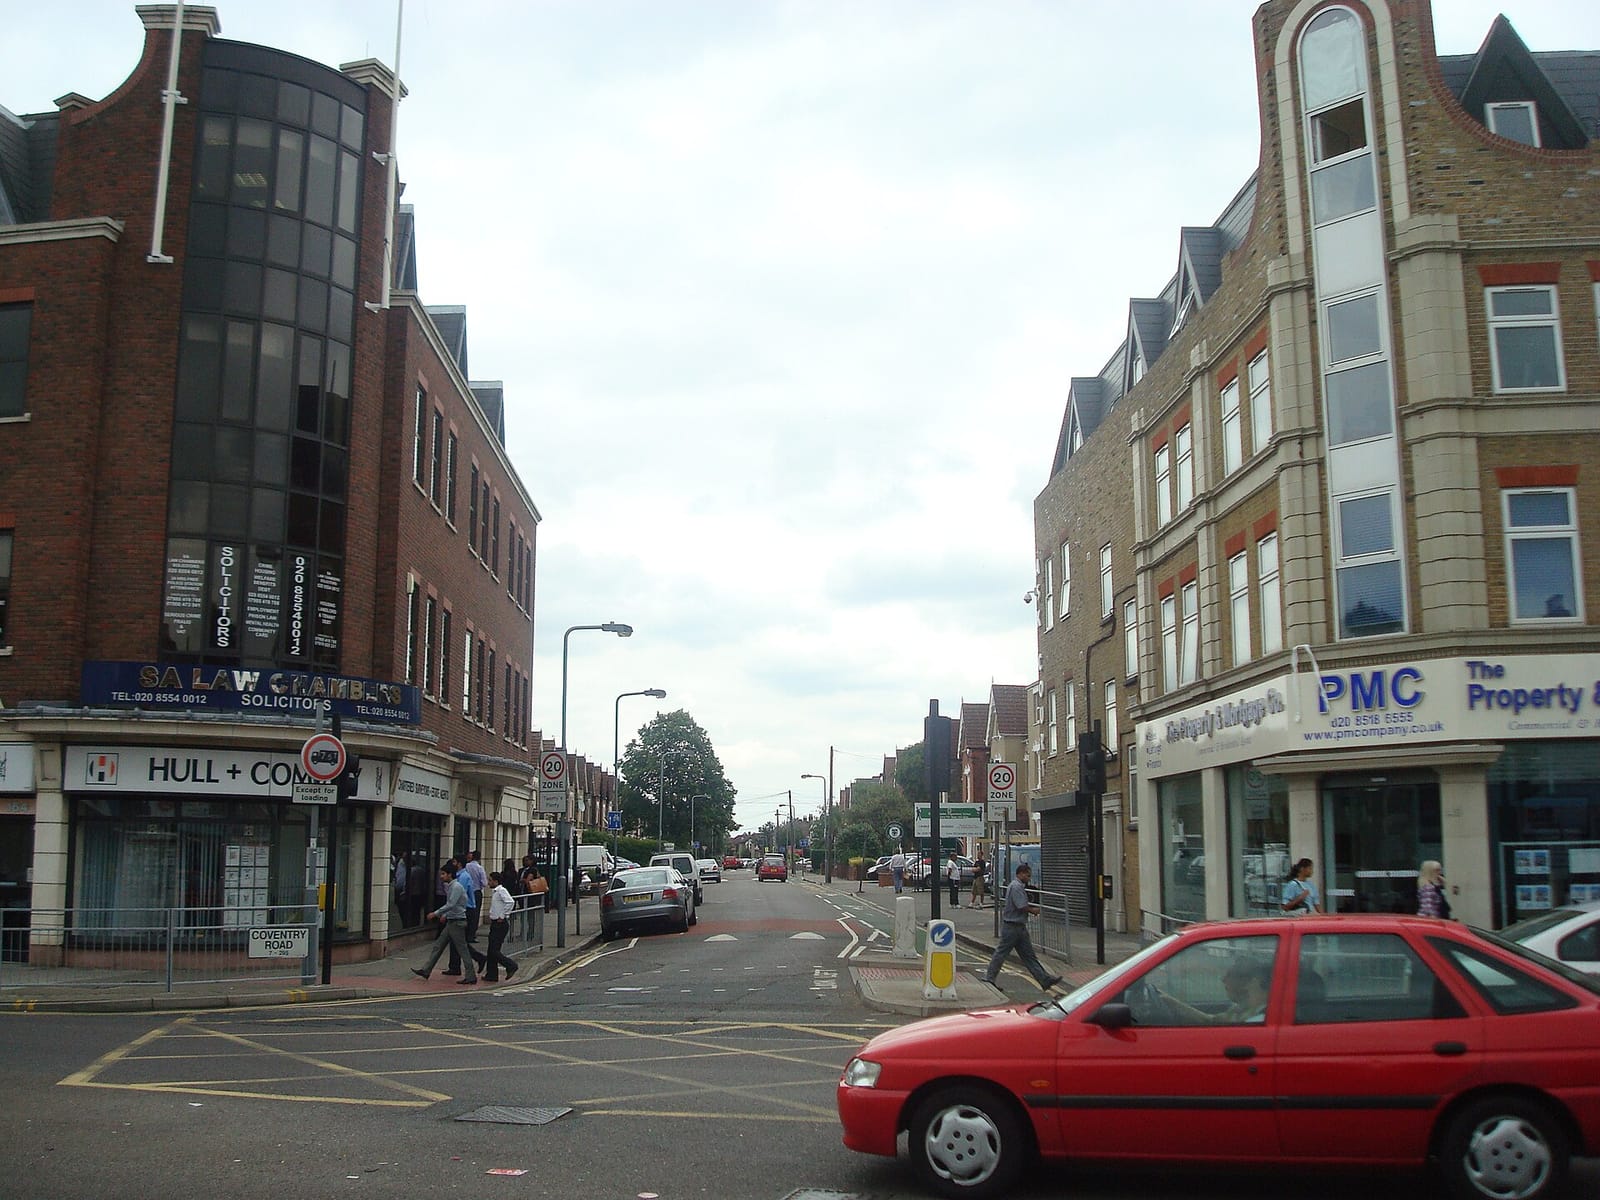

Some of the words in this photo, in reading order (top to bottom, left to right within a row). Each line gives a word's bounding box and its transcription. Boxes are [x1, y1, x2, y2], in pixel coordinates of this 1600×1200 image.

[217, 546, 233, 647] SOLICITORS
[1465, 660, 1505, 680] The
[140, 665, 183, 689] SA
[192, 667, 261, 691] LAW
[1318, 668, 1426, 714] PMC
[155, 693, 180, 703] 8554
[182, 694, 207, 704] 0012
[1467, 683, 1584, 715] Property
[1180, 710, 1213, 742] Property
[1223, 698, 1266, 729] Mortgage
[1331, 716, 1350, 728] 020
[1304, 721, 1444, 741] www.pmcompany.co.uk
[148, 757, 220, 784] HULL
[546, 761, 562, 773] 20
[993, 772, 1011, 783] 20
[296, 786, 323, 795] Except
[324, 787, 336, 795] for
[542, 781, 564, 789] ZONE
[301, 794, 329, 803] loading
[990, 791, 1014, 799] ZONE
[251, 930, 307, 940] COVENTRY
[265, 940, 294, 950] ROAD
